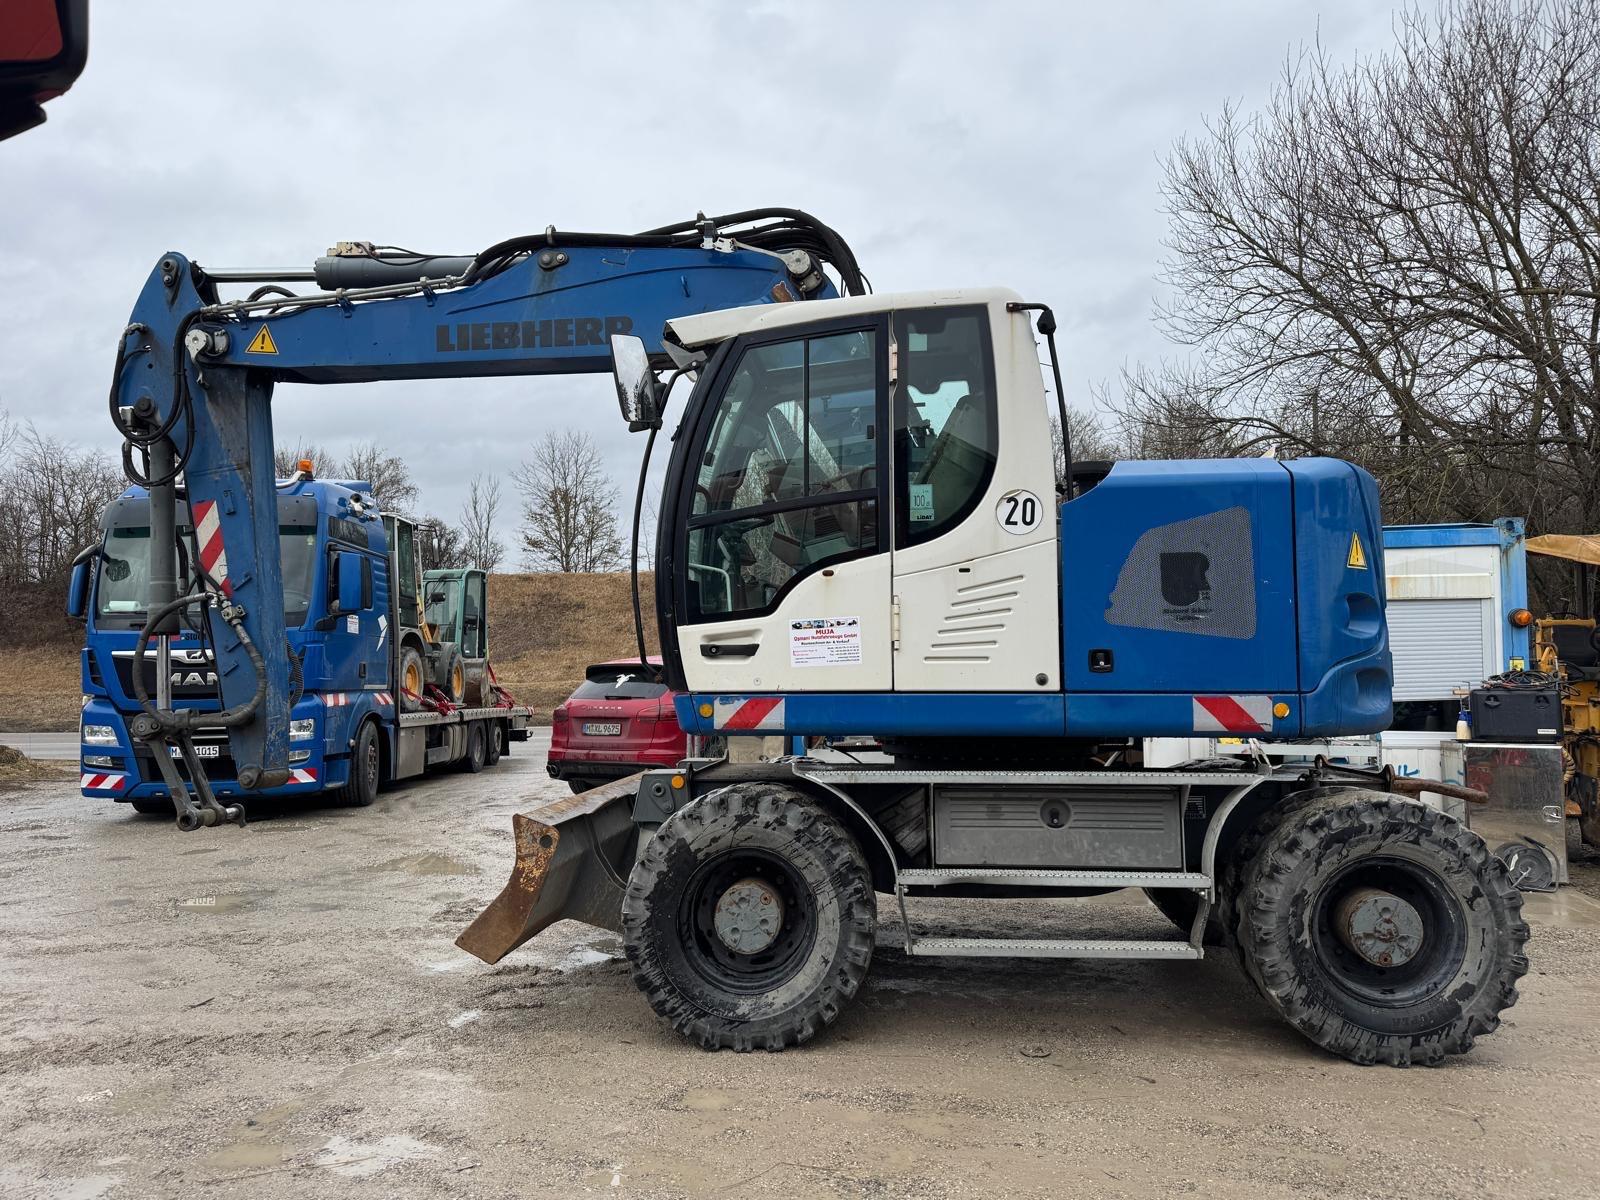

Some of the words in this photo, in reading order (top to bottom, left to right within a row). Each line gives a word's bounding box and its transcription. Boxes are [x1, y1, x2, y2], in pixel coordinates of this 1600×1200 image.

[914, 494, 925, 506] 100
[1005, 497, 1036, 526] 20
[196, 746, 218, 756] 1015
